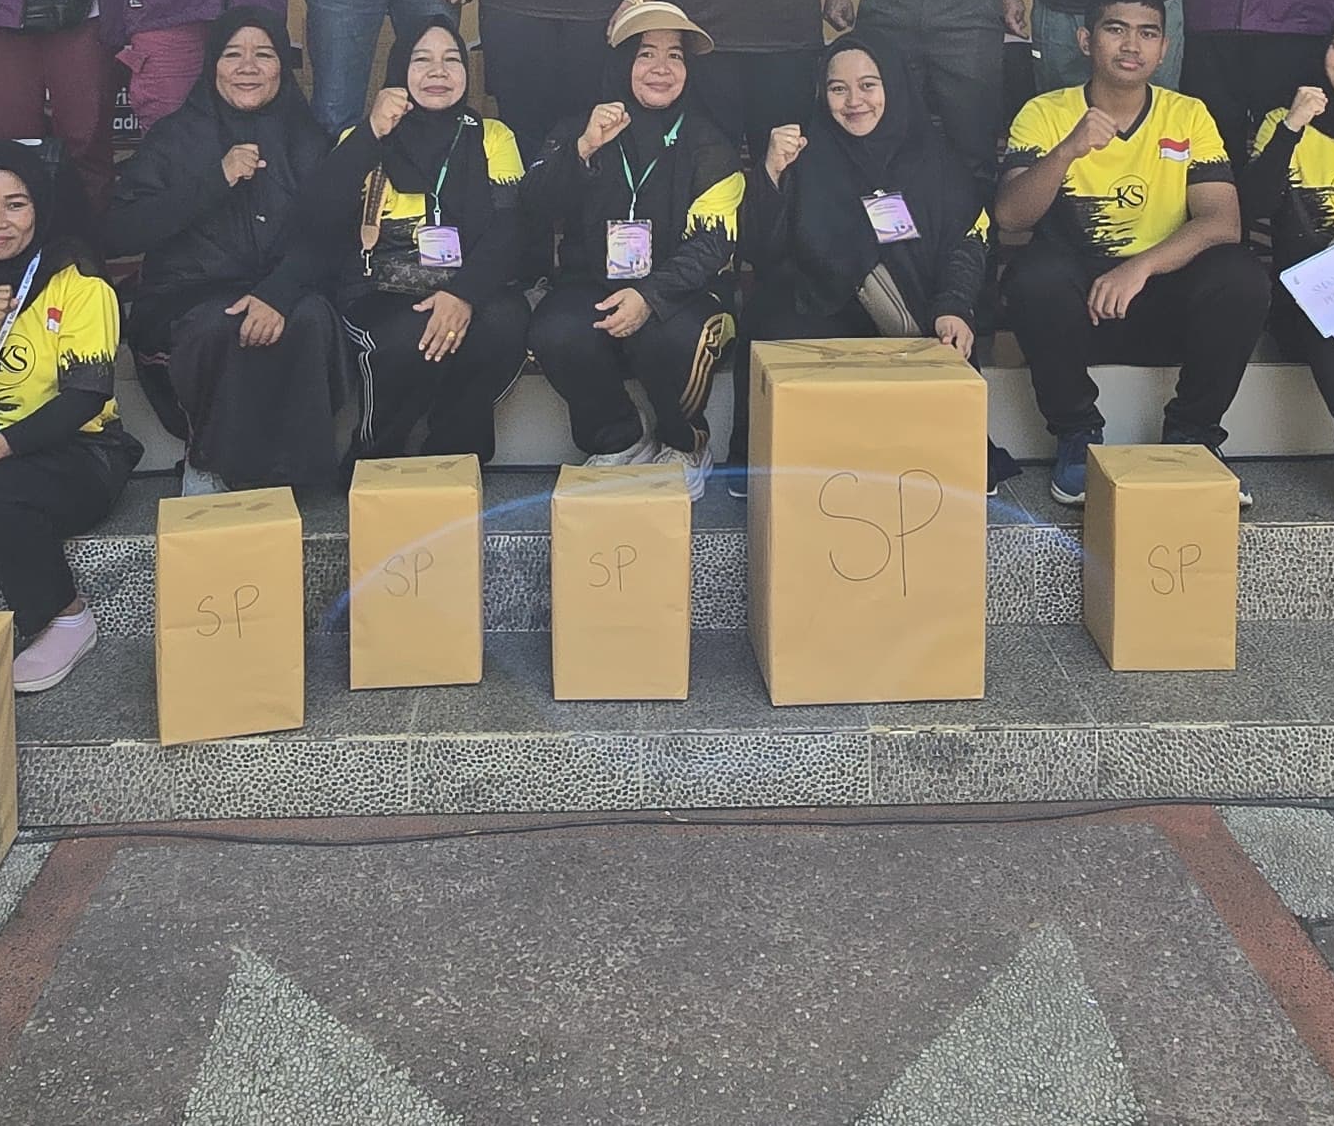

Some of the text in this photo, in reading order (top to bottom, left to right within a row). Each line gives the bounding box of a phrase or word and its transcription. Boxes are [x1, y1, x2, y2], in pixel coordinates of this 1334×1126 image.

[1114, 184, 1144, 210] KS
[818, 468, 944, 597] SP
[382, 547, 434, 598] SP
[588, 544, 637, 593] SP
[1147, 543, 1203, 596] SP
[196, 584, 262, 639] SP
